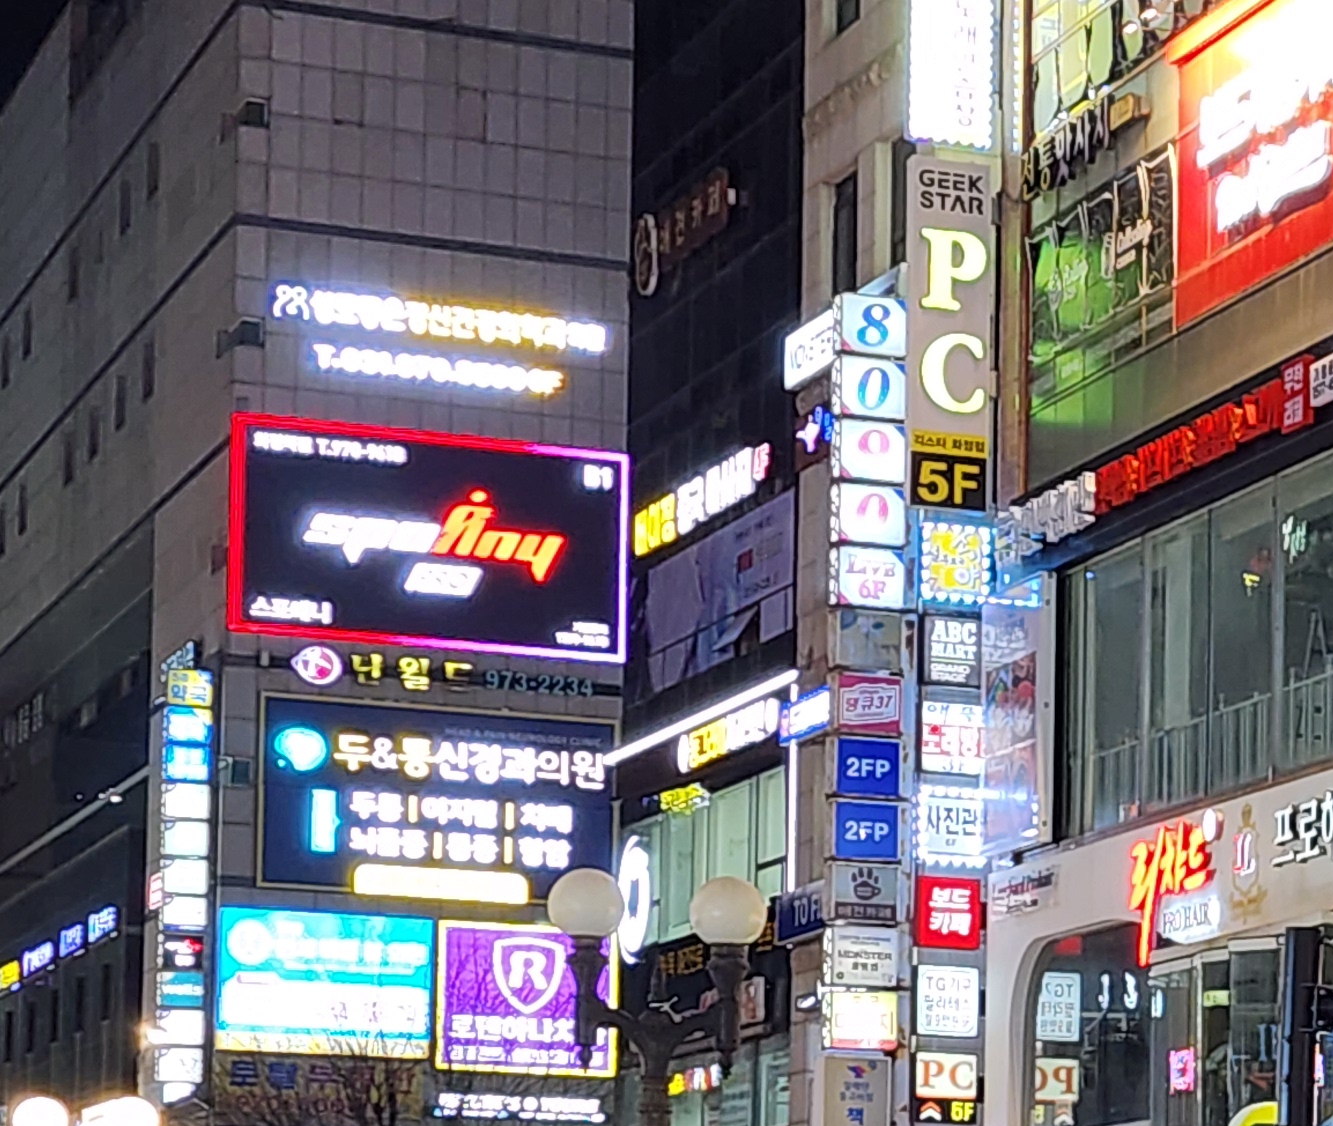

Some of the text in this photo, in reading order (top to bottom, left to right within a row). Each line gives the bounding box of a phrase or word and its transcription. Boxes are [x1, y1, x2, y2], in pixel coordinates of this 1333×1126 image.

[919, 169, 984, 194] GEEK
[920, 192, 984, 216] STAR
[920, 227, 988, 414] PC
[952, 438, 985, 454] 화정점
[917, 462, 981, 504] 5F
[858, 579, 886, 600] 6F
[931, 620, 976, 644] ABC
[930, 641, 976, 660] MART
[484, 668, 594, 698] 973-2234
[846, 757, 891, 778] 2FP
[927, 807, 978, 835] 사진관
[929, 886, 970, 909] 보드
[919, 1059, 975, 1091] PC
